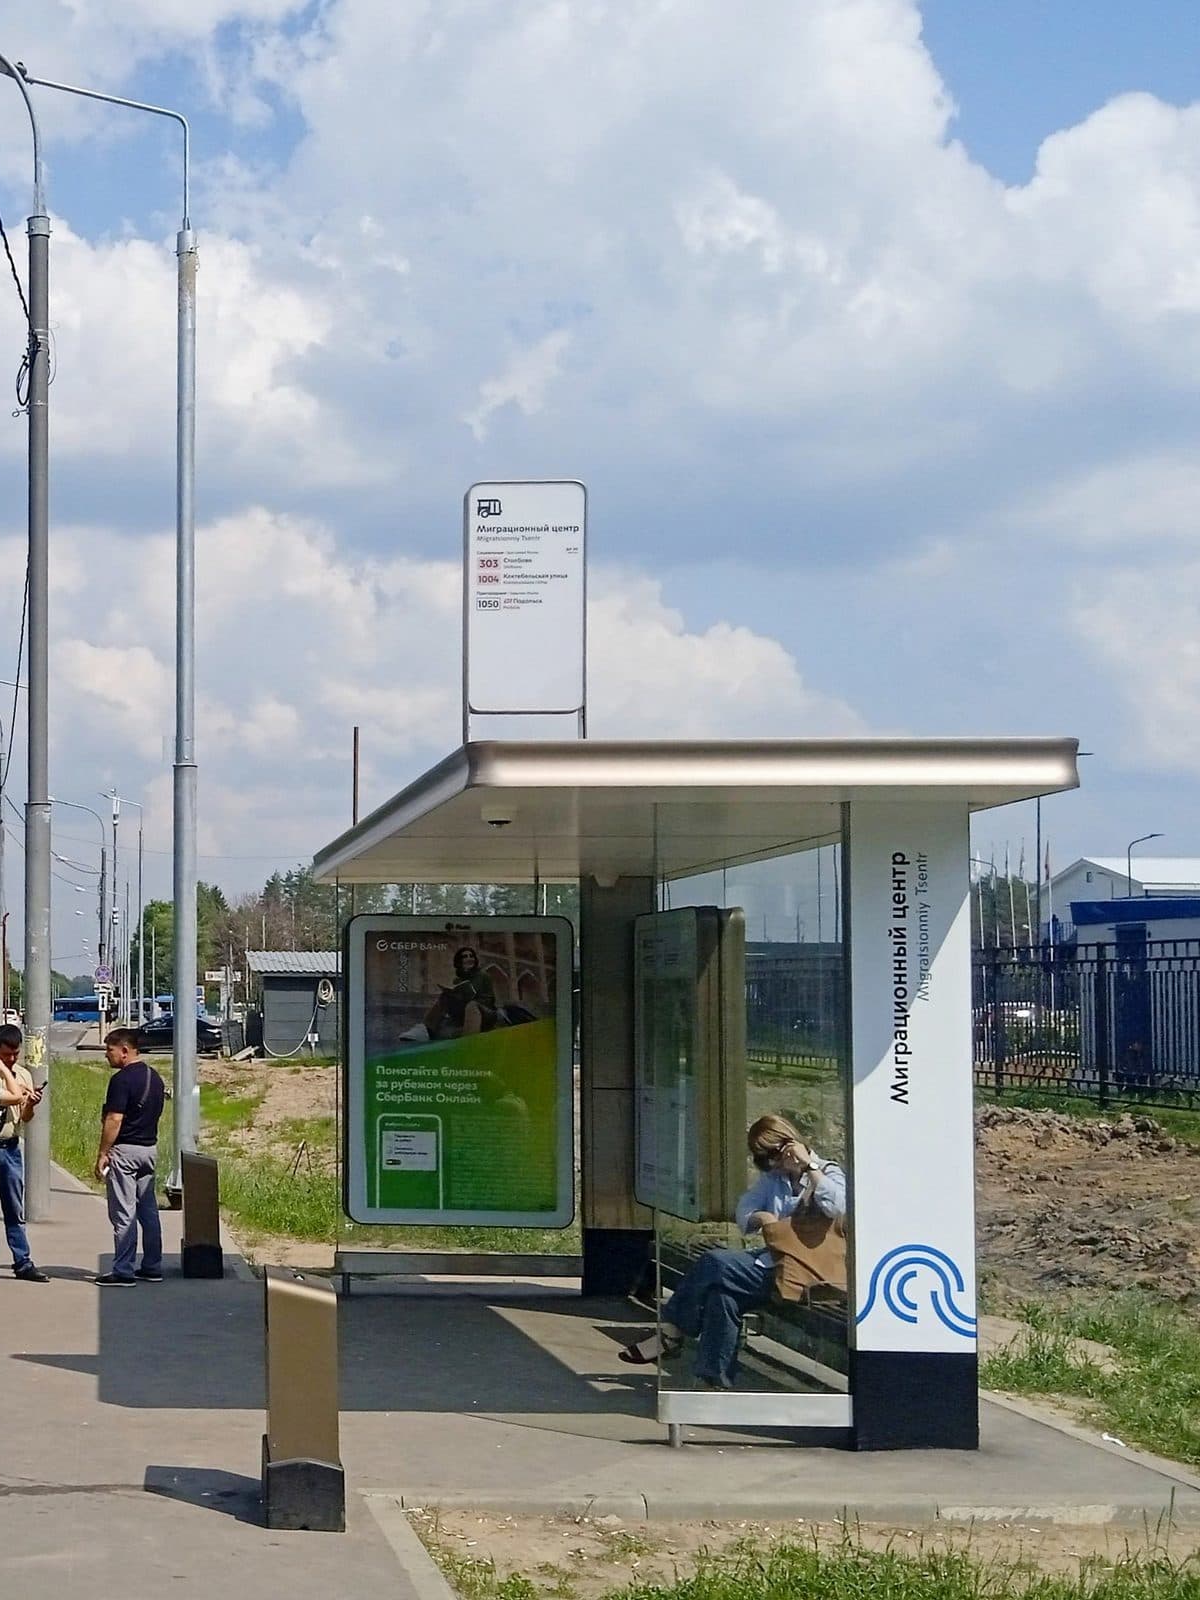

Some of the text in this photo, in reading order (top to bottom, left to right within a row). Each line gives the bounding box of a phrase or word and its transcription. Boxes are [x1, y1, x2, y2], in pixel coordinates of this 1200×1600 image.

[476, 524, 580, 534] Миграционный центр
[479, 559, 499, 569] 303
[478, 575, 499, 584] 1004
[478, 600, 499, 609] 1050
[914, 852, 933, 1002] Migratsionniy Tsentr
[390, 942, 417, 951] СБЕР
[887, 851, 913, 1105] Миграционный центр
[375, 1065, 492, 1077] Помогайте близким
[375, 1079, 478, 1092] за рубежом через
[375, 1092, 481, 1104] СберБанк Онлайн
